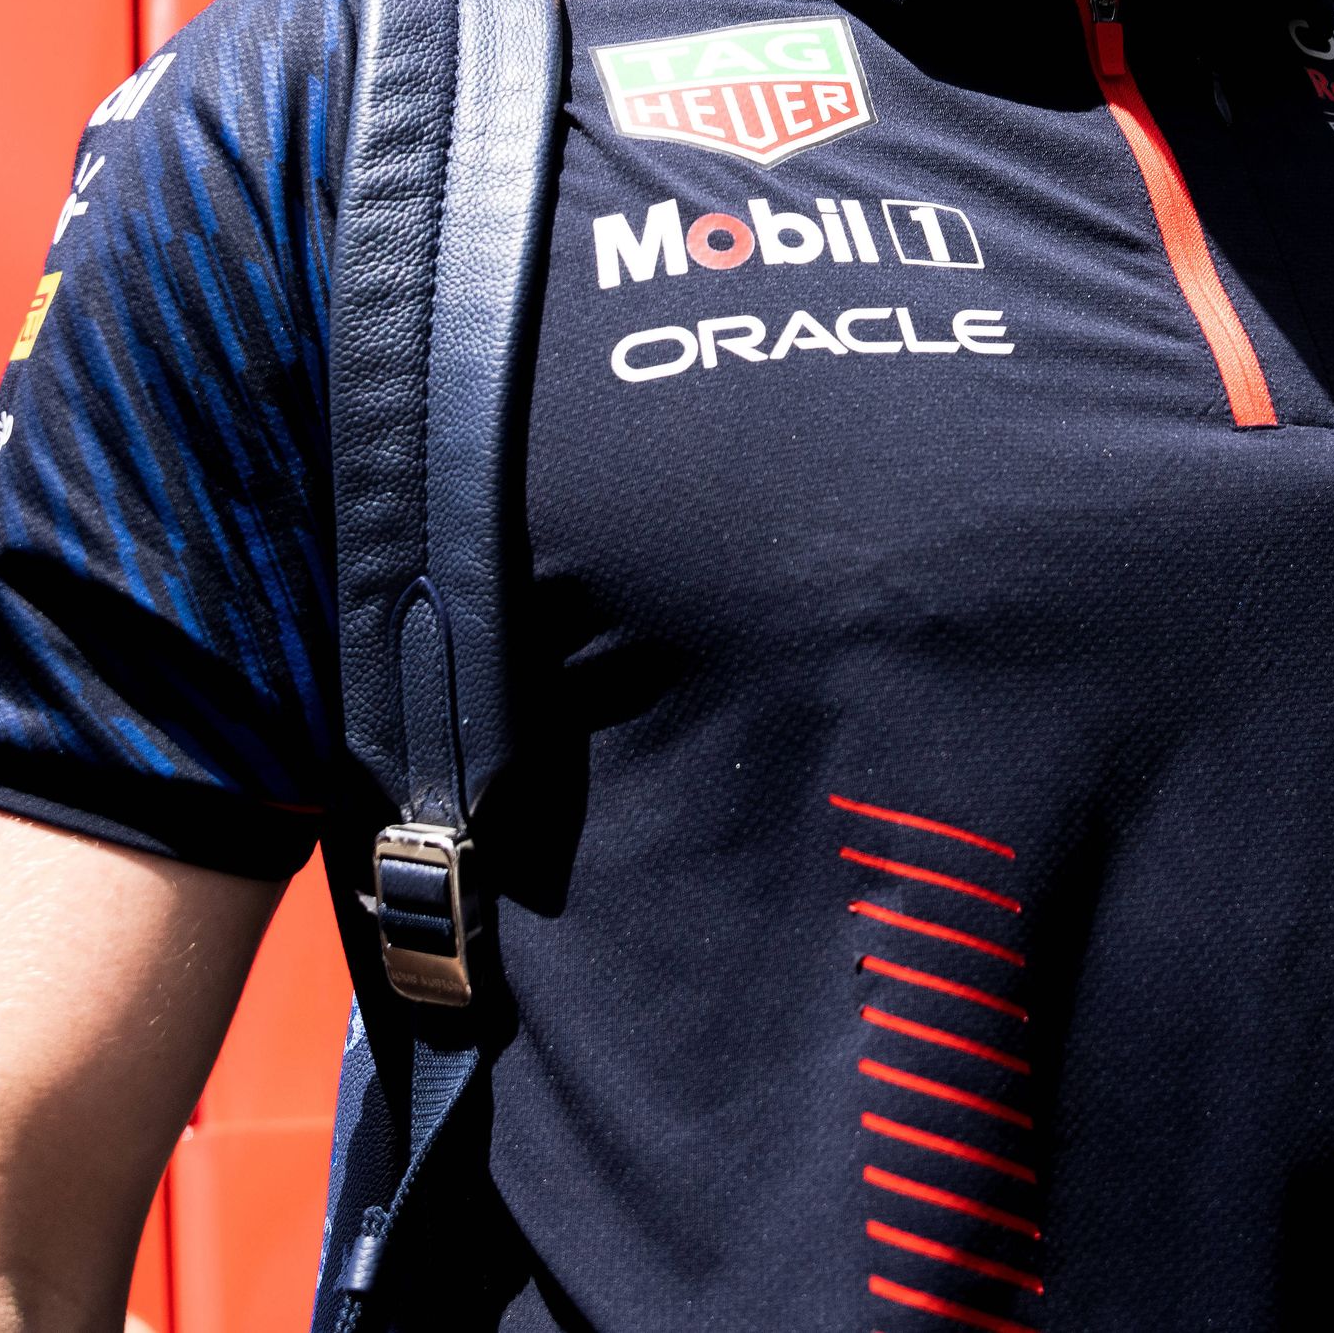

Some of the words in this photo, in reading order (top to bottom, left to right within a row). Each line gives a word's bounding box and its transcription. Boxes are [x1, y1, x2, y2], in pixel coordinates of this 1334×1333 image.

[620, 29, 835, 85] TAG
[633, 81, 854, 148] HEUER
[592, 196, 880, 289] Mobil
[905, 205, 952, 263] 1
[610, 307, 1016, 383] ORACLE
